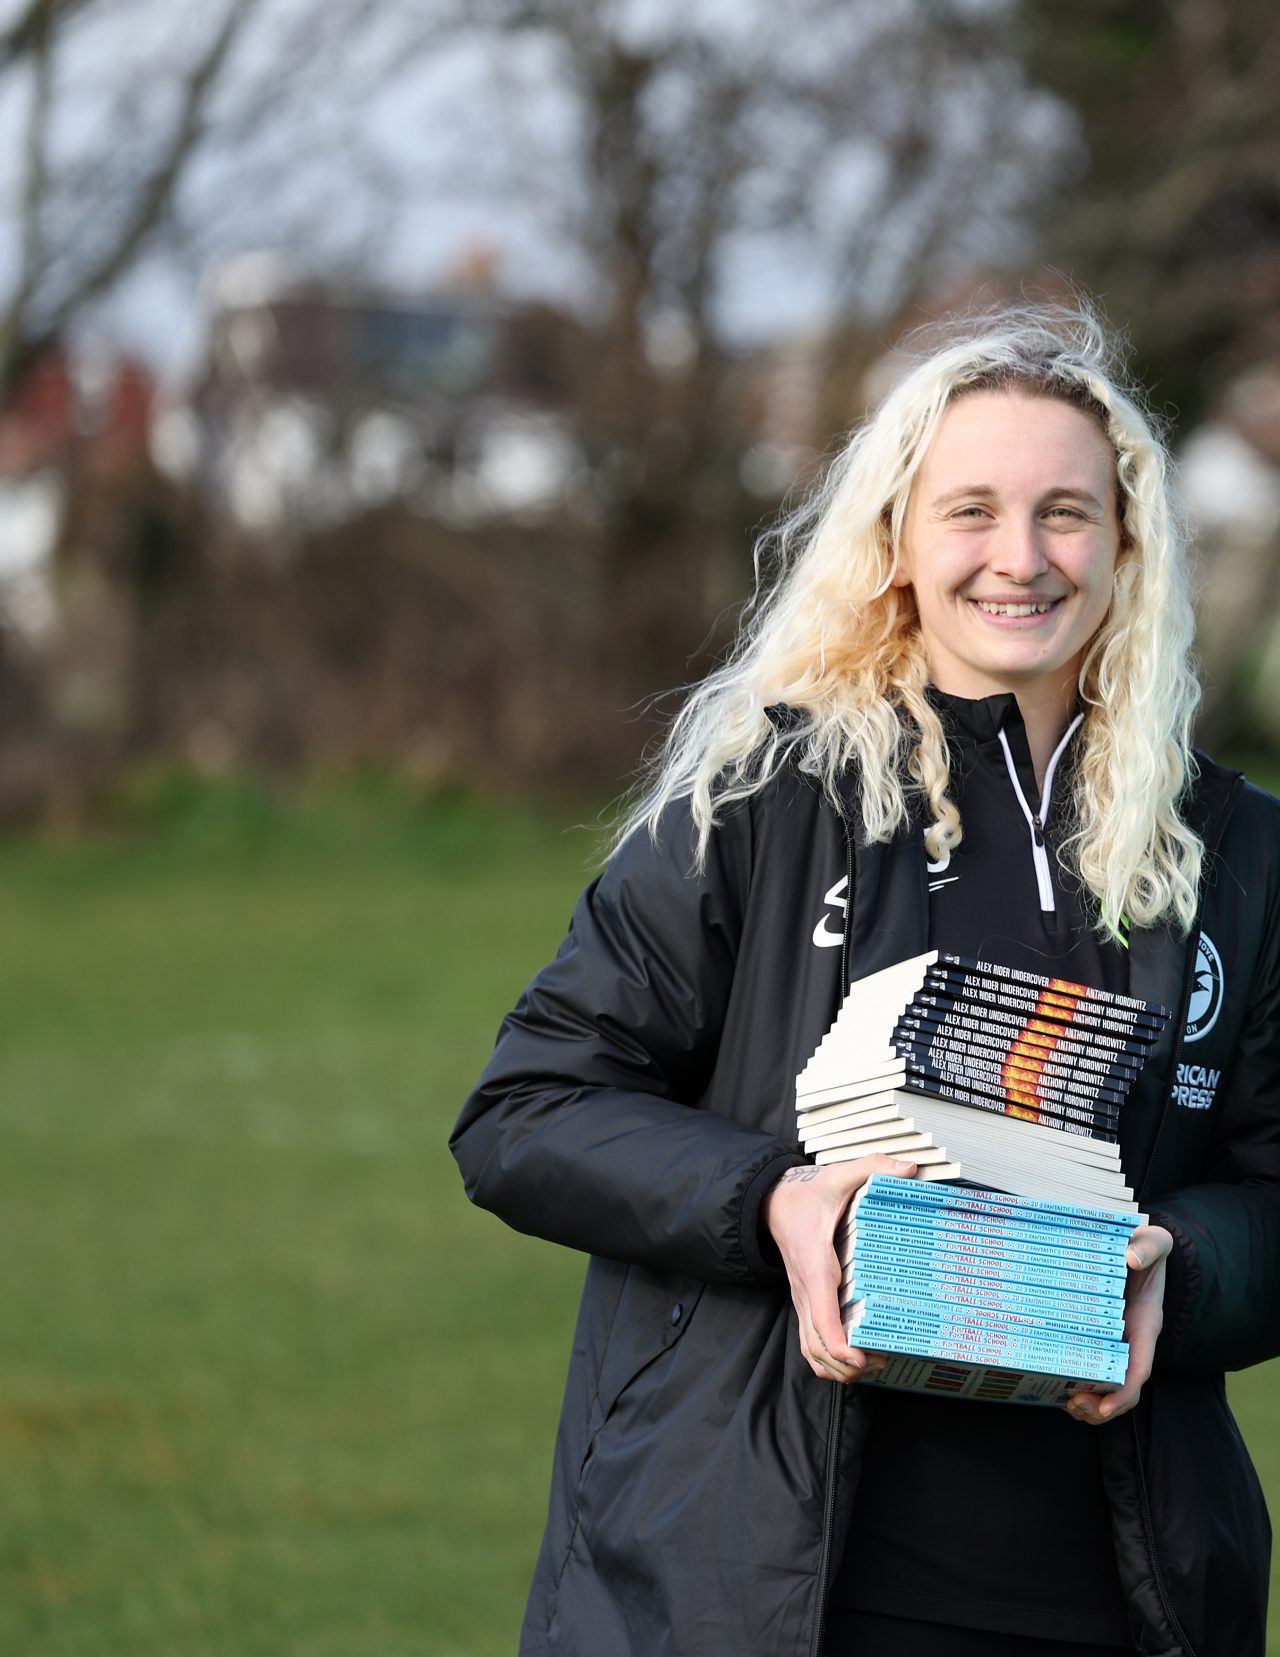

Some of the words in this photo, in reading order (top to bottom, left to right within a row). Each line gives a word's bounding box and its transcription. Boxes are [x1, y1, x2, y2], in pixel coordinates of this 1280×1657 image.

[976, 961, 992, 974] ALEX
[993, 964, 1010, 978] RIDER
[1011, 969, 1049, 987] UNDERCOVER
[1086, 987, 1114, 1003] ANTHONY
[1115, 995, 1146, 1011] HOROWITZ
[965, 975, 981, 988] ALEX
[982, 978, 999, 991] RIDER
[1000, 983, 1039, 1000] UNDERCOVER
[1076, 1001, 1105, 1016] ANTHONY
[1106, 1008, 1137, 1023] HOROWITZ
[962, 987, 979, 1000] ALEX
[979, 990, 996, 1003] RIDER
[998, 995, 1036, 1012] UNDERCOVER
[1073, 1013, 1101, 1028] ANTHONY
[1102, 1019, 1133, 1035] HOROWITZ
[953, 1001, 970, 1014] ALEX
[970, 1005, 988, 1018] RIDER
[989, 1009, 1027, 1027] UNDERCOVER
[1064, 1028, 1093, 1043] ANTHONY
[1094, 1034, 1126, 1050] HOROWITZ
[945, 1013, 961, 1026] ALEX
[962, 1016, 979, 1030] RIDER
[980, 1021, 1019, 1039] UNDERCOVER
[1056, 1040, 1085, 1055] ANTHONY
[1086, 1047, 1118, 1062] HOROWITZ
[937, 1025, 953, 1038] ALEX
[954, 1028, 971, 1041] RIDER
[973, 1033, 1011, 1050] UNDERCOVER
[1048, 1051, 1077, 1066] ANTHONY
[1078, 1058, 1110, 1074] HOROWITZ
[932, 1036, 948, 1049] ALEX
[949, 1040, 966, 1053] RIDER
[967, 1044, 1006, 1062] UNDERCOVER
[1043, 1063, 1072, 1079] ANTHONY
[1072, 1070, 1104, 1086] HOROWITZ
[928, 1047, 944, 1060] ALEX
[945, 1051, 962, 1064] RIDER
[964, 1055, 1002, 1073] UNDERCOVER
[1038, 1075, 1067, 1090] ANTHONY
[1068, 1082, 1100, 1098] HOROWITZ
[932, 1059, 947, 1072] ALEX
[948, 1062, 964, 1076] RIDER
[965, 1067, 1001, 1085] UNDERCOVER
[1036, 1085, 1063, 1102] ANTHONY
[1064, 1093, 1094, 1110] HOROWITZ
[940, 1071, 955, 1085] ALEX
[955, 1074, 971, 1089] RIDER
[972, 1079, 1006, 1098] UNDERCOVER
[1039, 1100, 1065, 1116] ANTHONY
[1066, 1107, 1094, 1124] HOROWITZ
[939, 1086, 954, 1099] ALEX
[954, 1089, 970, 1103] RIDER
[971, 1094, 1005, 1112] UNDERCOVER
[1038, 1114, 1063, 1130] ANTHONY
[1064, 1121, 1092, 1138] HOROWITZ
[995, 1194, 1018, 1203] SCHOOL
[990, 1206, 1013, 1214] SCHOOL
[983, 1216, 1006, 1224] SCHOOL
[980, 1226, 1003, 1235] SCHOOL
[981, 1239, 1004, 1247] SCHOOL
[981, 1249, 1005, 1257] SCHOOL
[979, 1259, 1002, 1268] SCHOOL
[977, 1269, 1000, 1277] SCHOOL
[979, 1280, 1003, 1289] SCHOOL
[976, 1289, 1000, 1298] SCHOOL
[980, 1300, 1003, 1308] SCHOOL
[975, 1310, 999, 1318] SCHOOL
[986, 1321, 1009, 1329] SCHOOL
[984, 1337, 1008, 1346] SCHOOL
[978, 1347, 1002, 1355] SCHOOL
[976, 1356, 1000, 1364] SCHOOL
